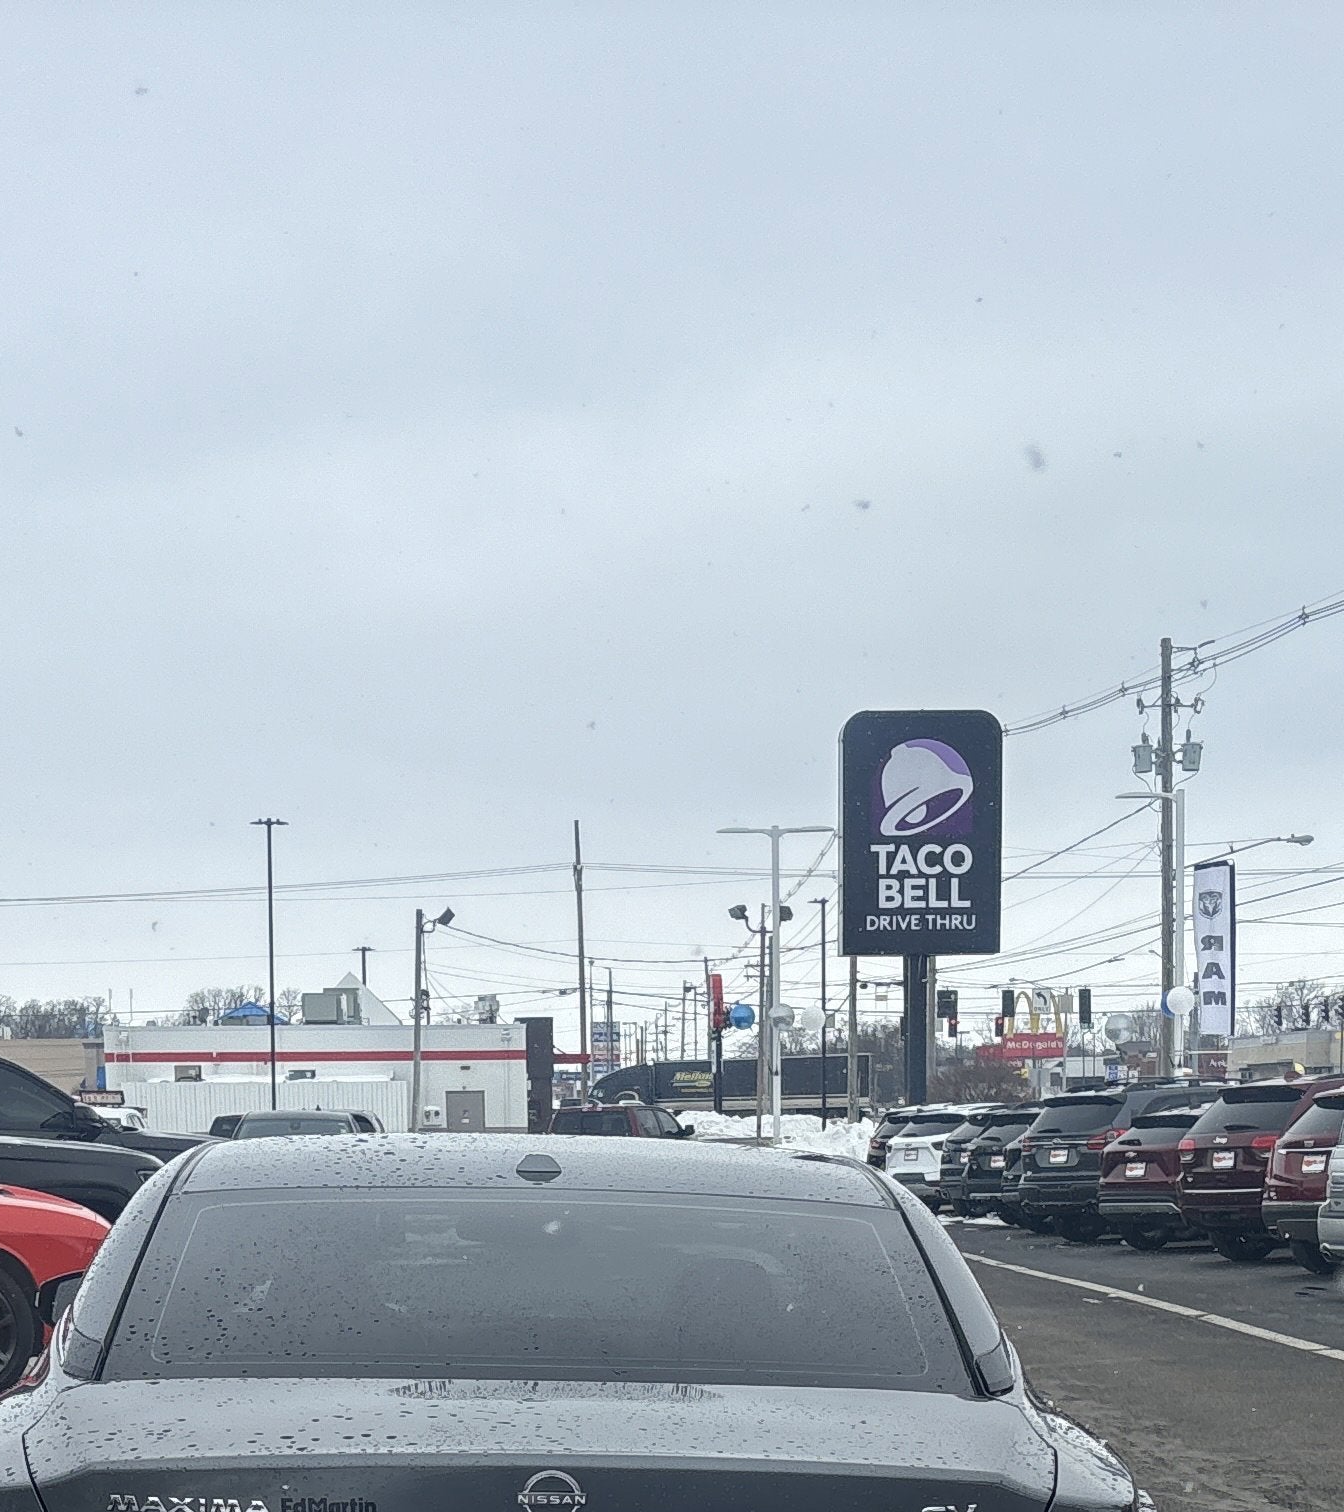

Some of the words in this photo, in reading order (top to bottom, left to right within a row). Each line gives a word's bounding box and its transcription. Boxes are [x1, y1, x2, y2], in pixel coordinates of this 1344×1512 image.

[870, 843, 973, 875] TACO
[878, 878, 971, 909] BELL
[866, 915, 922, 931] DRIVE
[925, 914, 976, 930] THRU
[517, 1494, 586, 1505] NISSAN
